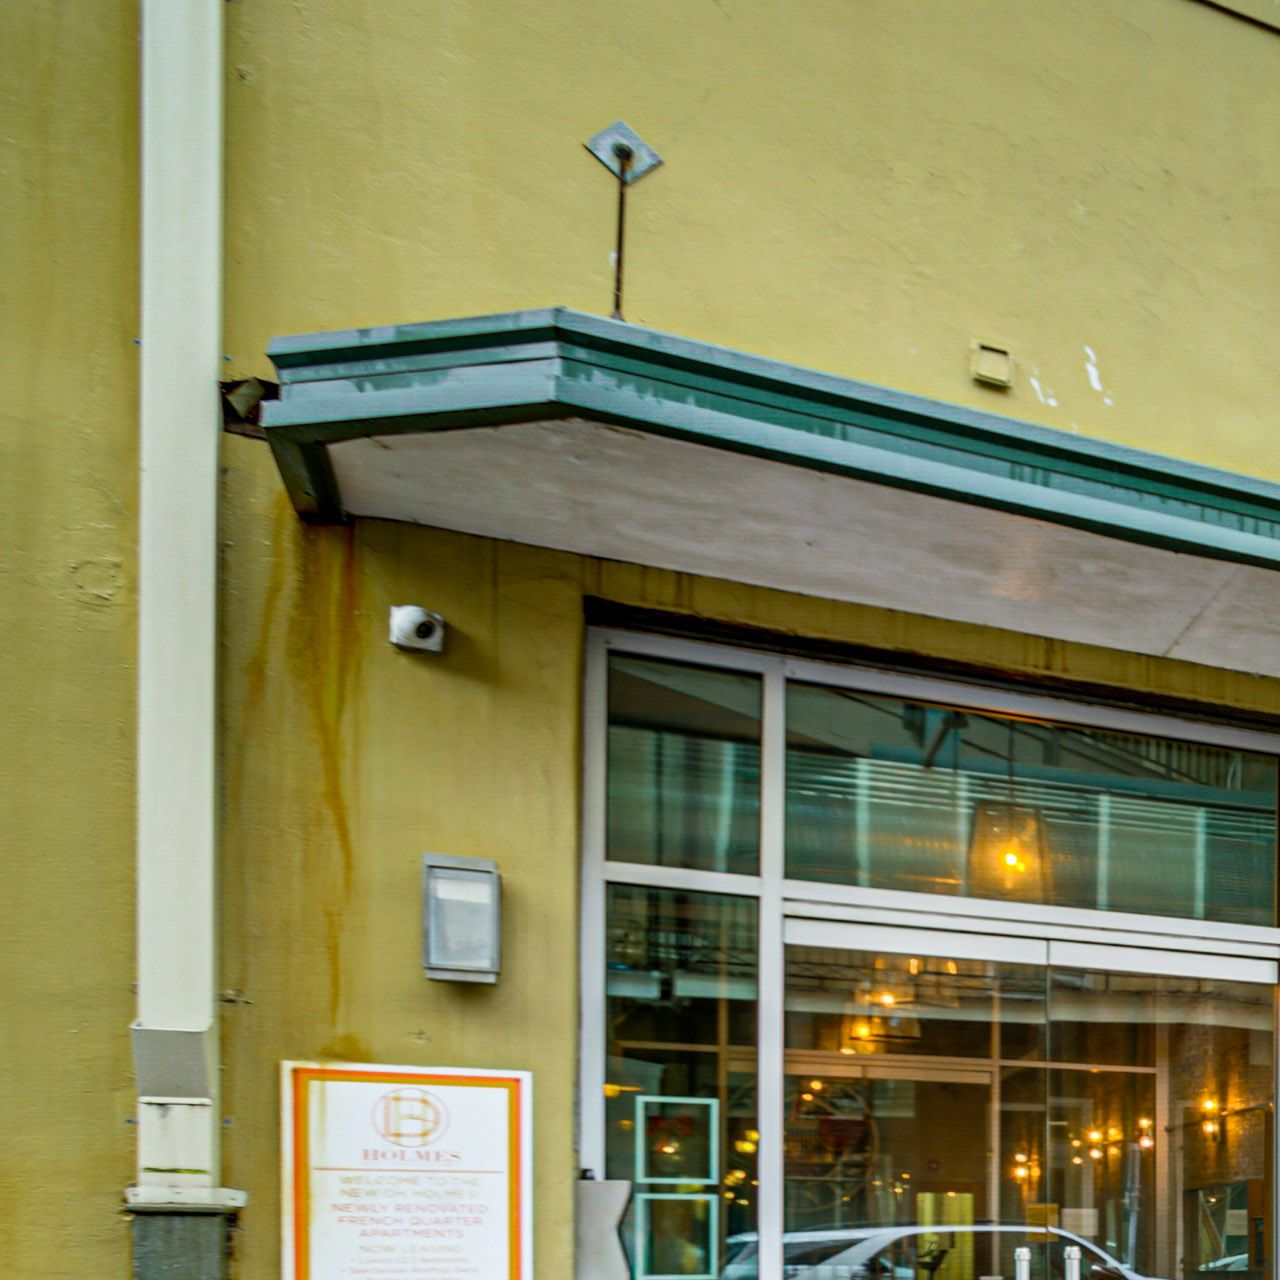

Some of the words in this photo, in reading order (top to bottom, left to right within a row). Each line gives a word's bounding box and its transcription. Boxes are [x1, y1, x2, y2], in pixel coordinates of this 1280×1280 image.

[361, 1148, 462, 1162] HOLMES
[393, 1203, 488, 1214] RENOVATED
[336, 1215, 404, 1226] FRENCH
[408, 1216, 484, 1227] QUARTER
[358, 1229, 465, 1239] APARTMENTS
